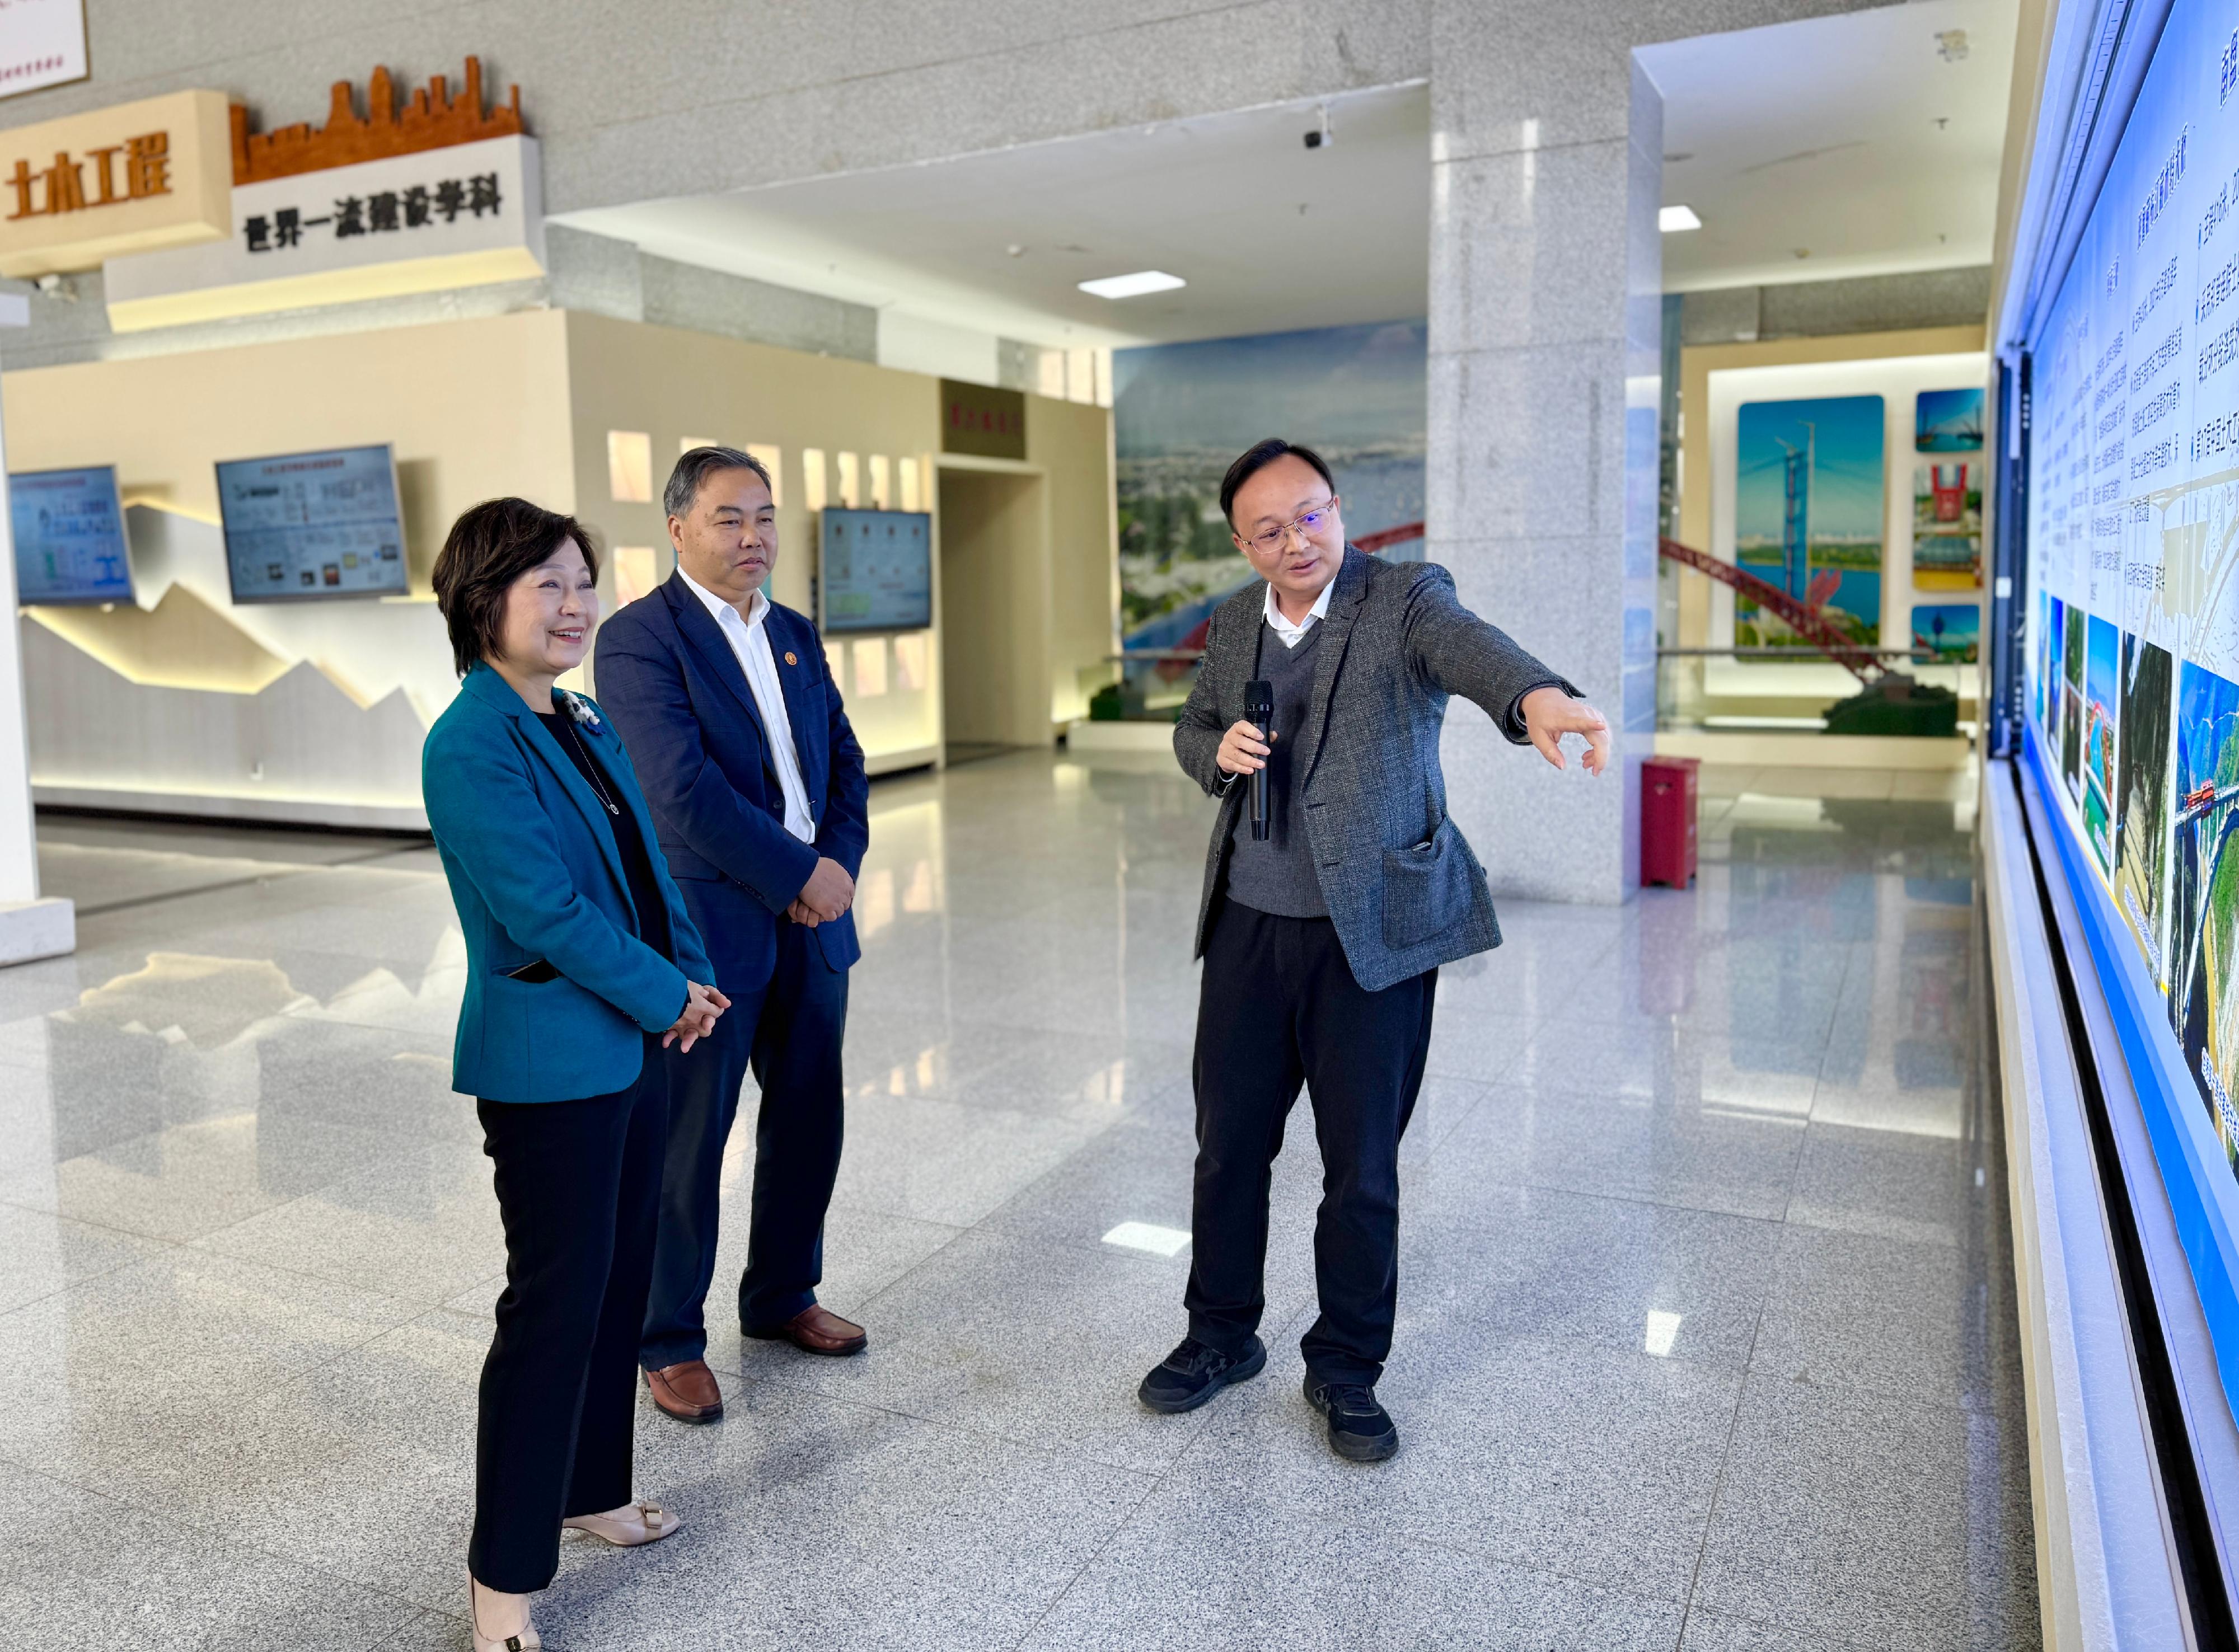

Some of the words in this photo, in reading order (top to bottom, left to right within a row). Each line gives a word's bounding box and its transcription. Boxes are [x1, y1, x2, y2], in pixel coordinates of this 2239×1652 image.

[2220, 28, 2239, 107] 南盘
[5, 130, 172, 221] 土木工程
[243, 172, 502, 253] 世界一流建设学科
[2196, 409, 2239, 463] 第17届中国土木工
